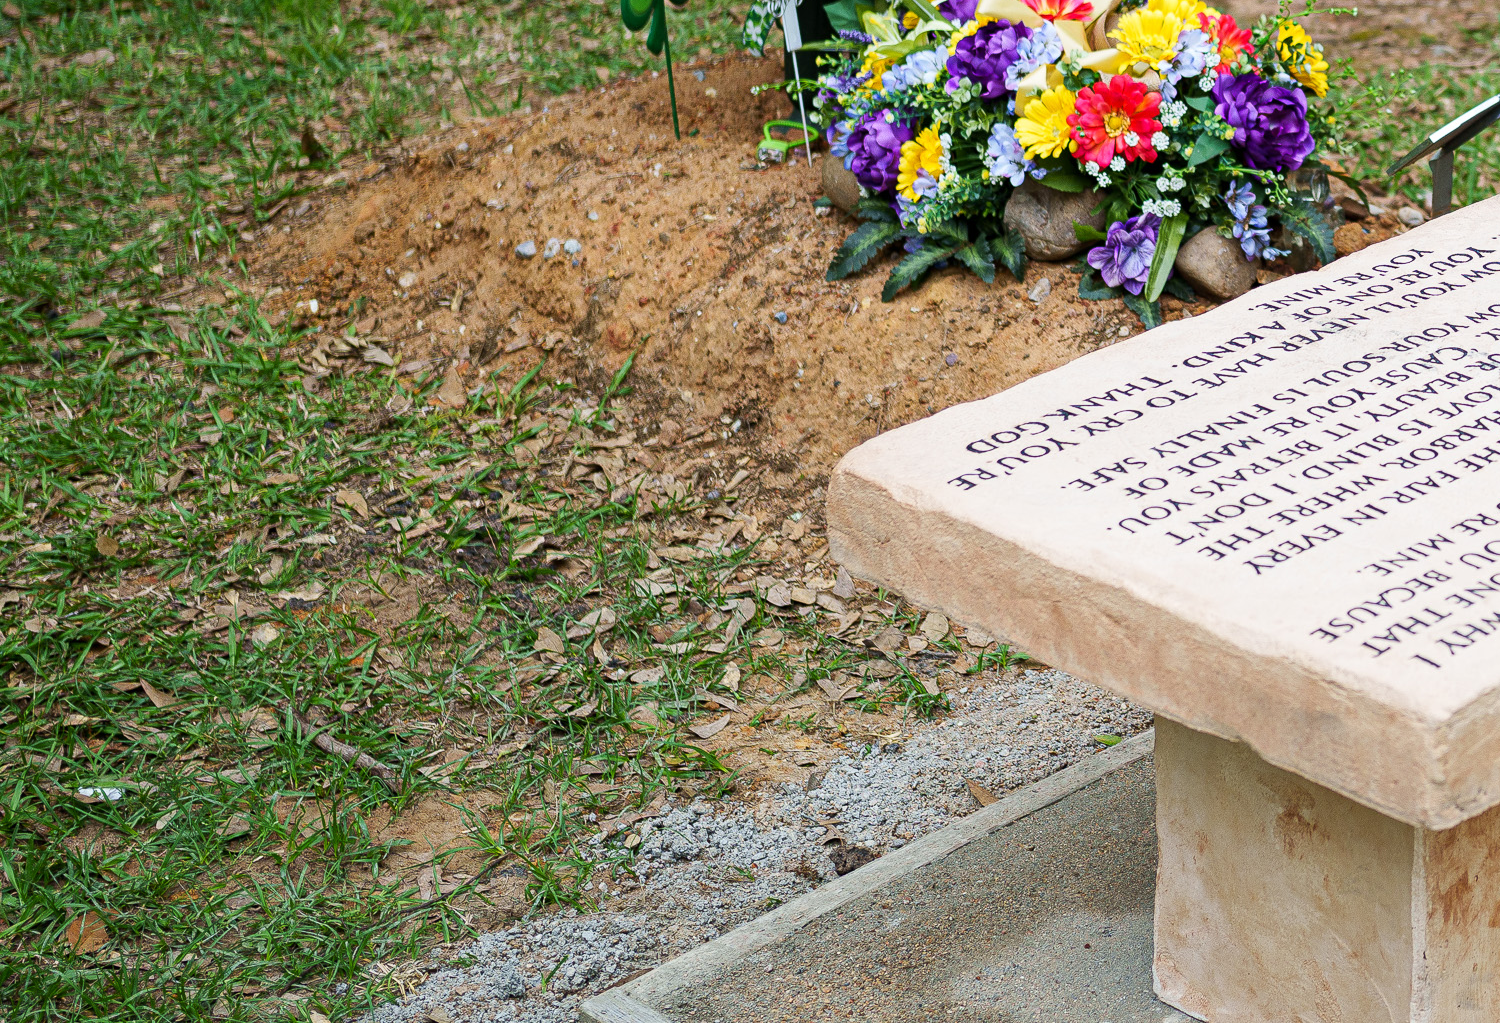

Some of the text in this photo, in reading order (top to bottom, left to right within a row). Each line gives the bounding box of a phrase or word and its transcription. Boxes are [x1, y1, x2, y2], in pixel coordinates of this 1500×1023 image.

[1390, 245, 1497, 287] YOU'RE
[1290, 305, 1333, 324] OF
[1328, 283, 1395, 308] ONE
[1363, 280, 1467, 315] YOU'LL
[1257, 319, 1287, 331] A
[1267, 312, 1371, 353] NEVER
[1378, 321, 1471, 353] YOUR
[1170, 330, 1266, 369] KIND.
[1368, 346, 1480, 389] 'CAUSE
[1190, 352, 1277, 390] HAVE
[1301, 352, 1387, 388] SOUL
[1042, 375, 1174, 422] THANK
[1145, 388, 1199, 409] TO
[1261, 387, 1378, 438] YOU'RE
[1271, 387, 1310, 405] IS
[1353, 370, 1474, 424] BEAUTY,
[965, 420, 1051, 455] GOD
[1069, 408, 1145, 438] CRY.
[1149, 402, 1276, 460] FINALLY
[1321, 422, 1360, 443] IT
[946, 436, 1081, 492] YOU'RE
[1060, 456, 1148, 492] SAFE.
[1167, 434, 1265, 478] MADE
[1188, 438, 1324, 499] BETRAYS
[1123, 476, 1170, 500] OF
[1267, 474, 1389, 527] WHERE
[1379, 469, 1461, 505] FAIR
[1106, 497, 1195, 535] YOU.
[1341, 502, 1389, 527] IN
[1197, 525, 1275, 562] THE
[1242, 523, 1344, 576] EVERY
[1356, 533, 1455, 577] MINE.
[1309, 569, 1453, 643] BECAUSE
[1361, 607, 1453, 658] THAT
[1412, 653, 1442, 669] I
